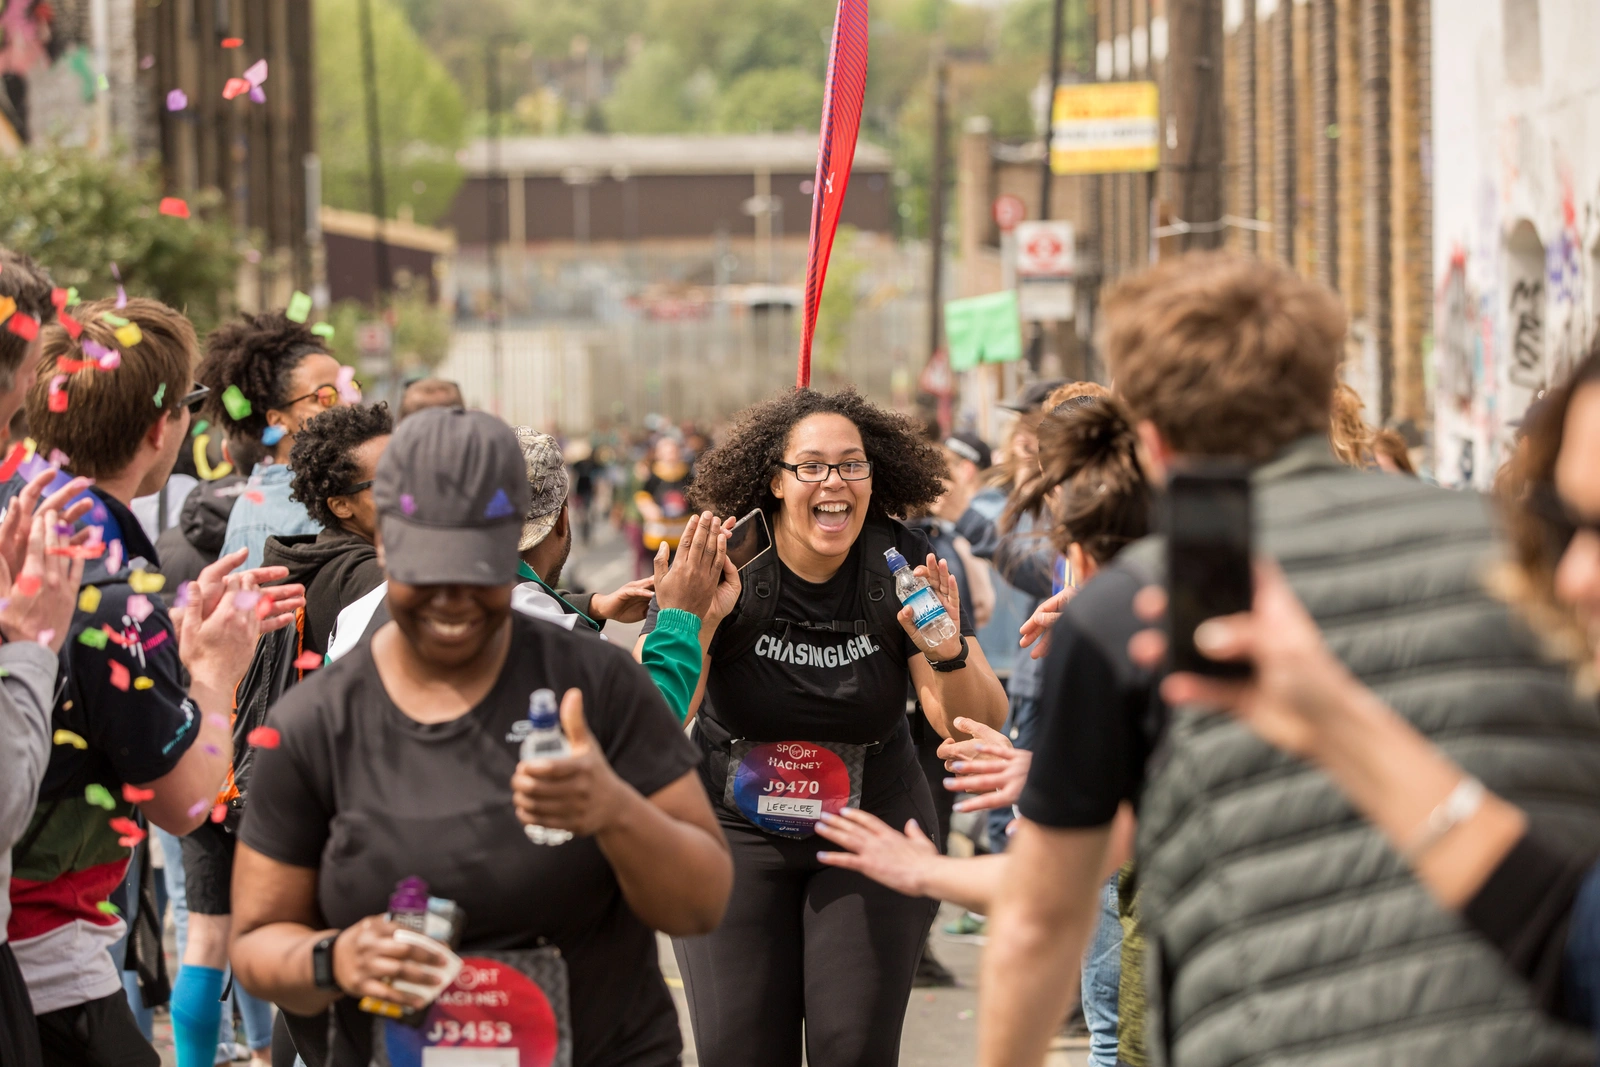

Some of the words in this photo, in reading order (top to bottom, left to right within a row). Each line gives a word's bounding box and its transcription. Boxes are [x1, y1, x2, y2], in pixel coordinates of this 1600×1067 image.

[776, 743, 818, 760] SPORT
[767, 756, 823, 770] HACKNEY
[763, 780, 819, 794] J9470
[426, 1020, 513, 1044] J3453
